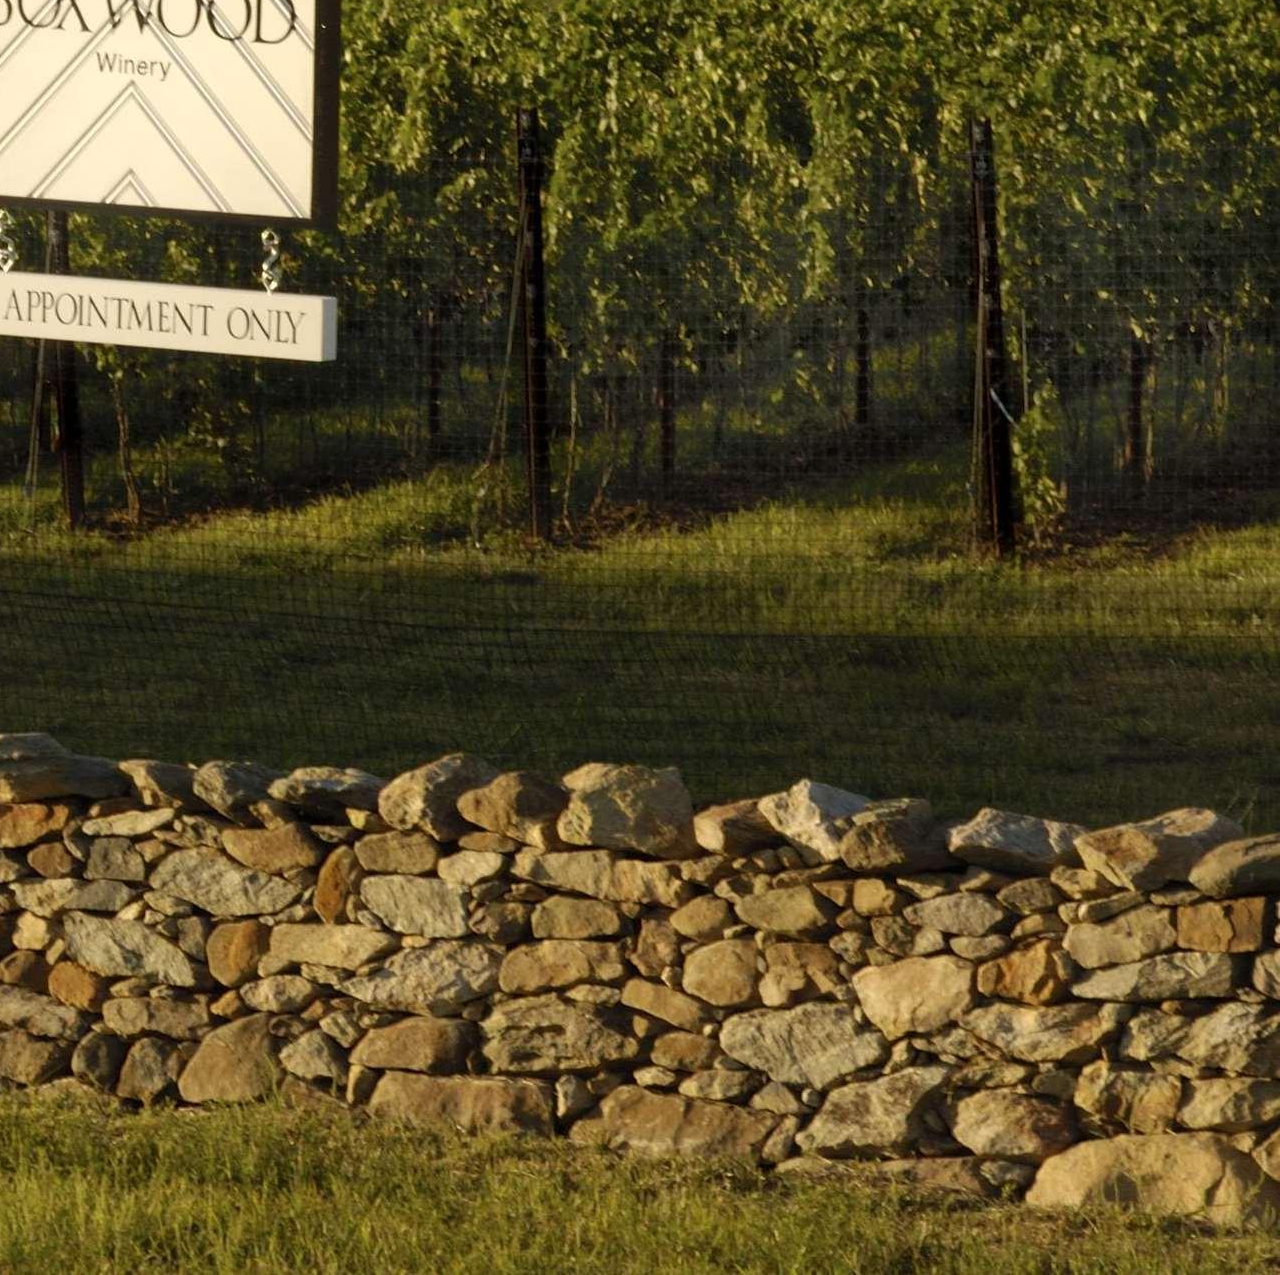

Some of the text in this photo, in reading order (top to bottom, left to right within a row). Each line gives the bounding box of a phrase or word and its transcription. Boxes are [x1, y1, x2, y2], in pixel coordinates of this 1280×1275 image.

[96, 51, 172, 80] Winery
[3, 287, 215, 337] APPOINTMENT
[226, 306, 306, 345] ONLY
